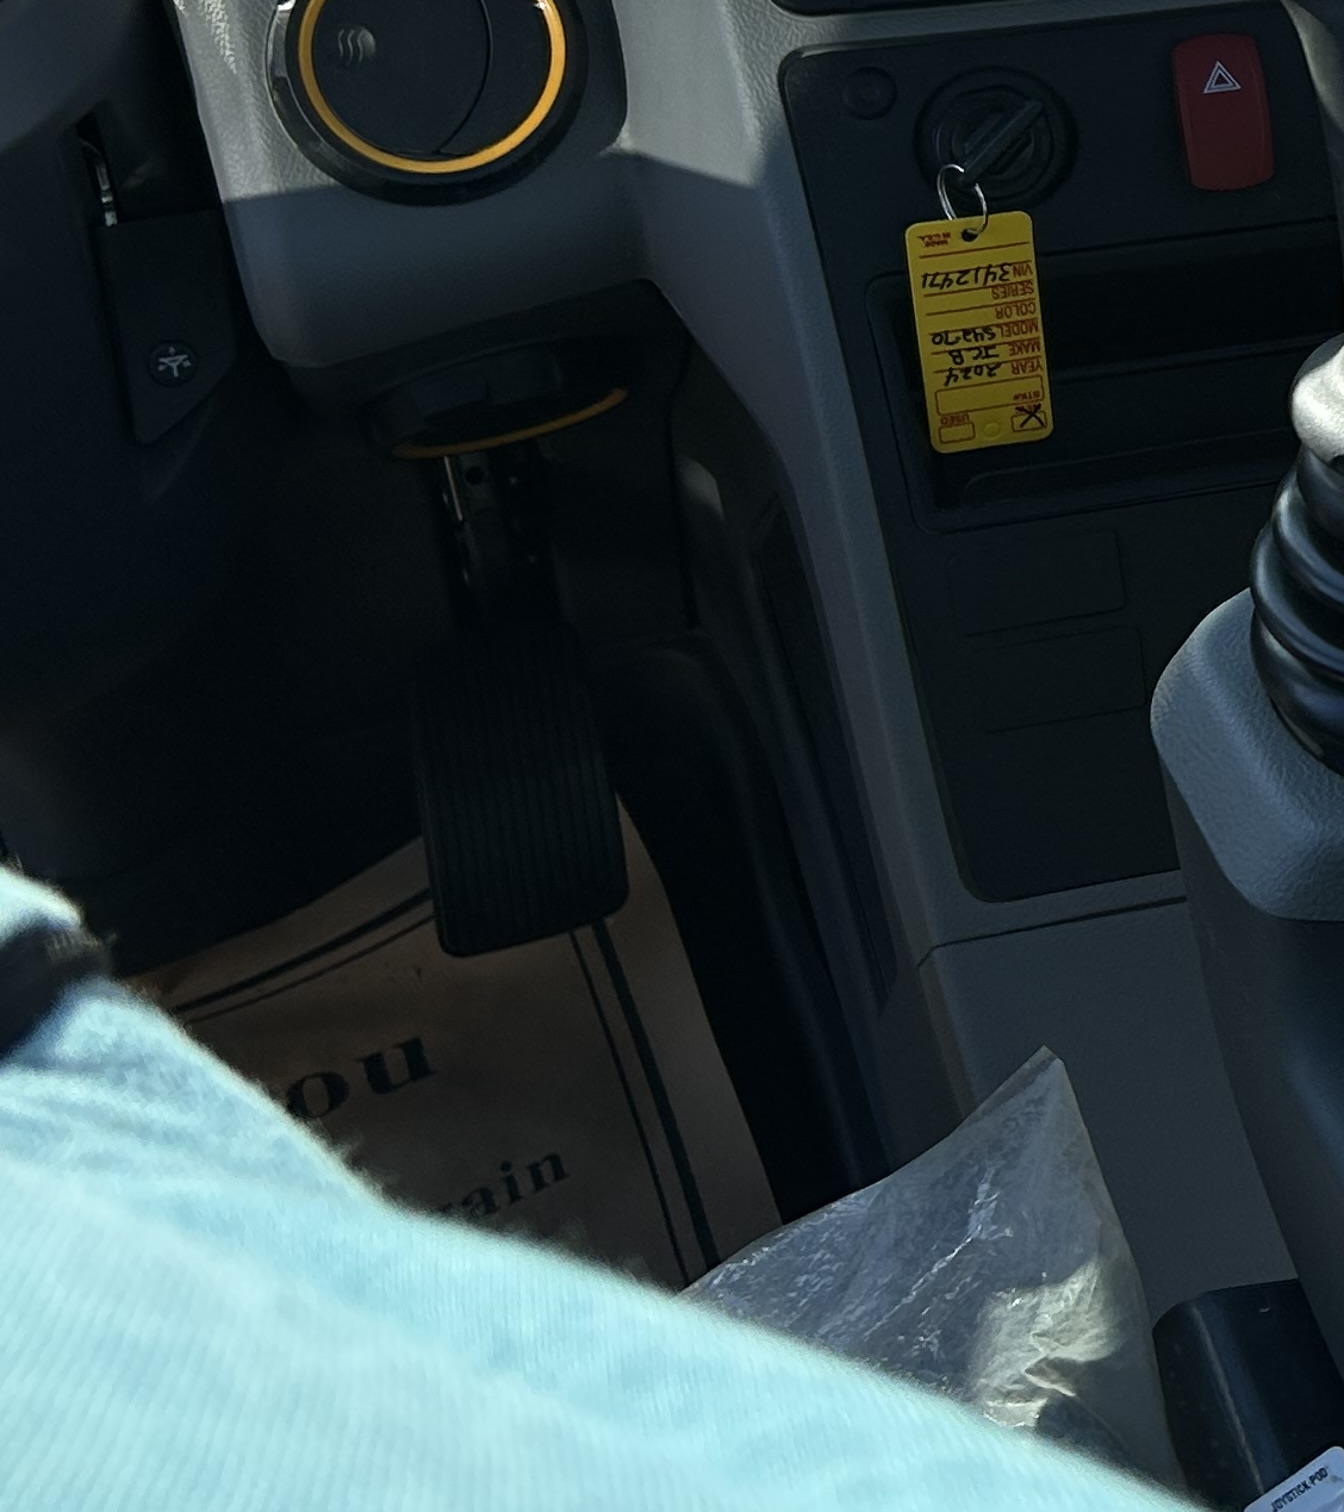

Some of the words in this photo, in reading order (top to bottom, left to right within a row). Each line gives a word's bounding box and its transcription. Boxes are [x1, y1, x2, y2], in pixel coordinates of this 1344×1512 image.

[1011, 262, 1033, 278] VIN
[991, 281, 1035, 300] SERIES
[994, 301, 1037, 320] COLOR
[1000, 319, 1040, 338] MODEL
[1008, 339, 1042, 357] MAKE
[943, 361, 1002, 388] 2024
[1011, 360, 1044, 376] YEAR
[284, 1037, 437, 1120] ou
